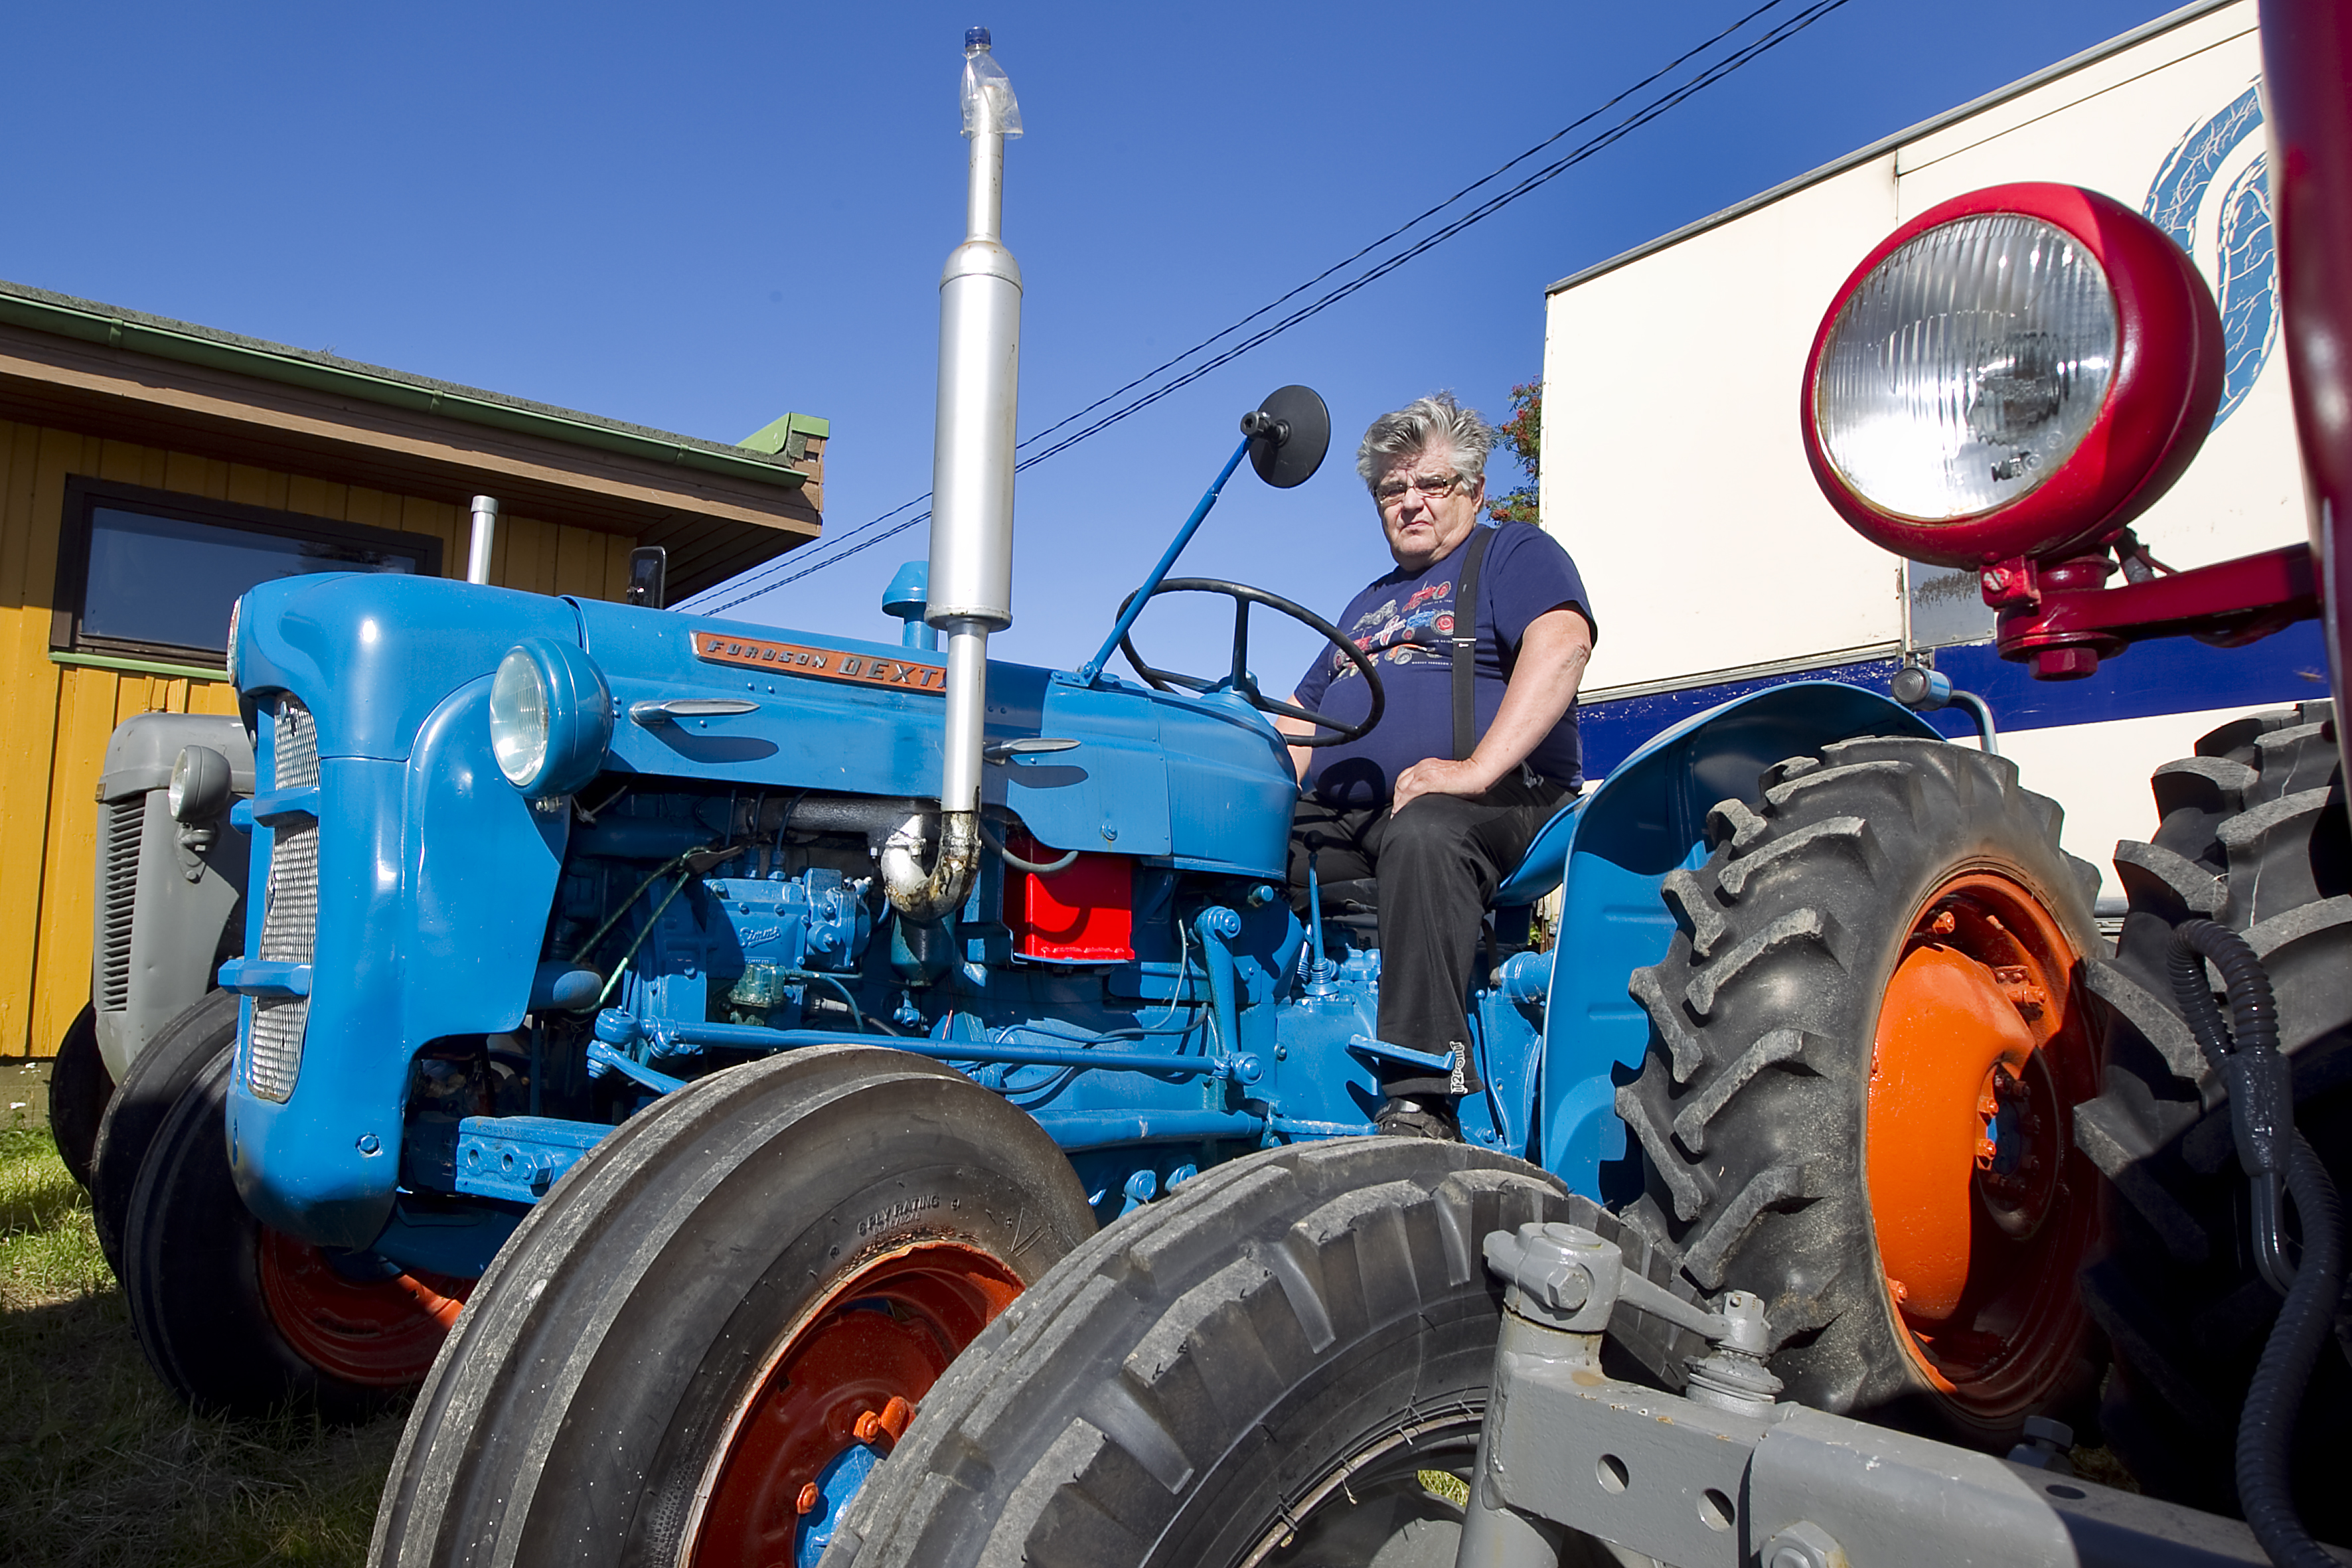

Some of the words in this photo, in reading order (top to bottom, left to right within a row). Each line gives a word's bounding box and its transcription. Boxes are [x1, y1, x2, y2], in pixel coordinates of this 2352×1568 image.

[707, 640, 827, 668] FORDSON
[857, 1221, 867, 1236] 6
[867, 1207, 891, 1229] PLY
[893, 1195, 939, 1217] RATING
